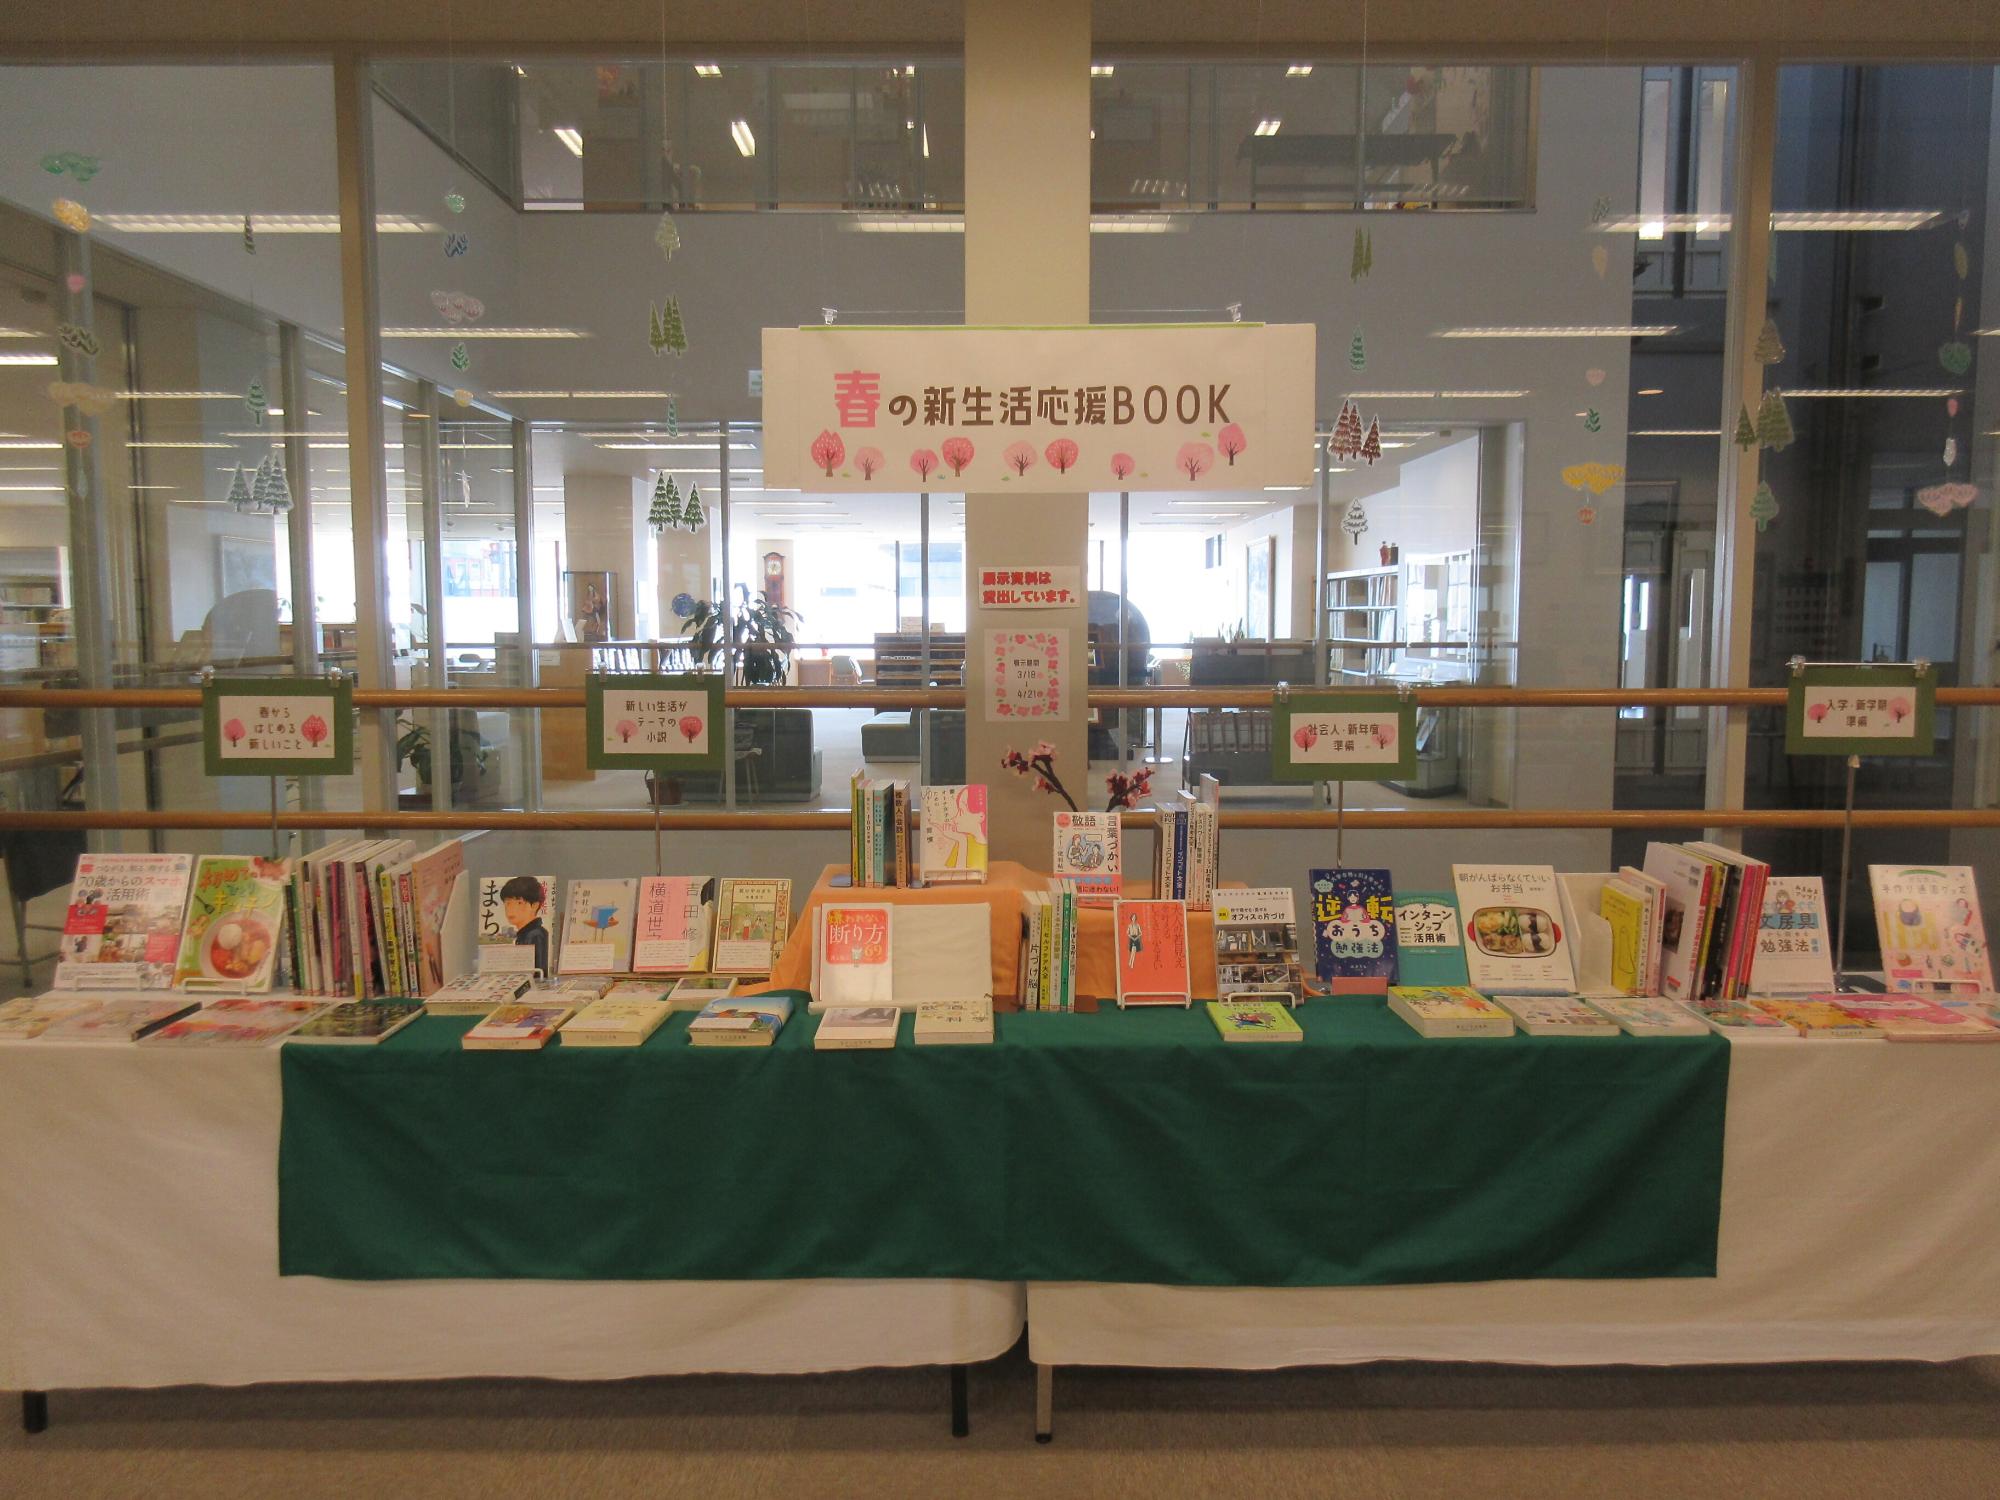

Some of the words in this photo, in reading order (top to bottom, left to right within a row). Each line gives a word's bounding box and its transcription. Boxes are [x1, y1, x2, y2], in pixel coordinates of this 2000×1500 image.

[833, 369, 1232, 429] 春の新生活応援BOOK
[982, 571, 1052, 586] 展示資料は
[259, 706, 291, 719] 春から
[625, 700, 688, 713] 新しい生活が
[637, 717, 677, 728] テーマの
[1845, 715, 1868, 728] 準備
[254, 723, 296, 734] はじめる
[1307, 723, 1380, 737] 社会人・新年度
[646, 731, 667, 743] 小説
[248, 738, 303, 750] 新しいこと
[1333, 739, 1355, 752] 準備
[1071, 815, 1097, 828] 敬語
[1106, 815, 1119, 872] 言葉づかい
[1458, 872, 1552, 883] 朝がんばらなくていい
[1490, 883, 1525, 894] お弁当
[481, 879, 500, 937] まち
[1315, 894, 1393, 922] 逆転
[682, 883, 701, 958] 吉田修一
[1398, 910, 1453, 922] インターン
[1759, 912, 1817, 930] 文房具
[1332, 924, 1380, 937] おうち
[1414, 920, 1444, 932] シップ
[829, 923, 886, 945] 断り方
[1413, 933, 1447, 944] 活用術
[1335, 942, 1379, 955] 勉強法
[1760, 938, 1810, 953] 勉強法
